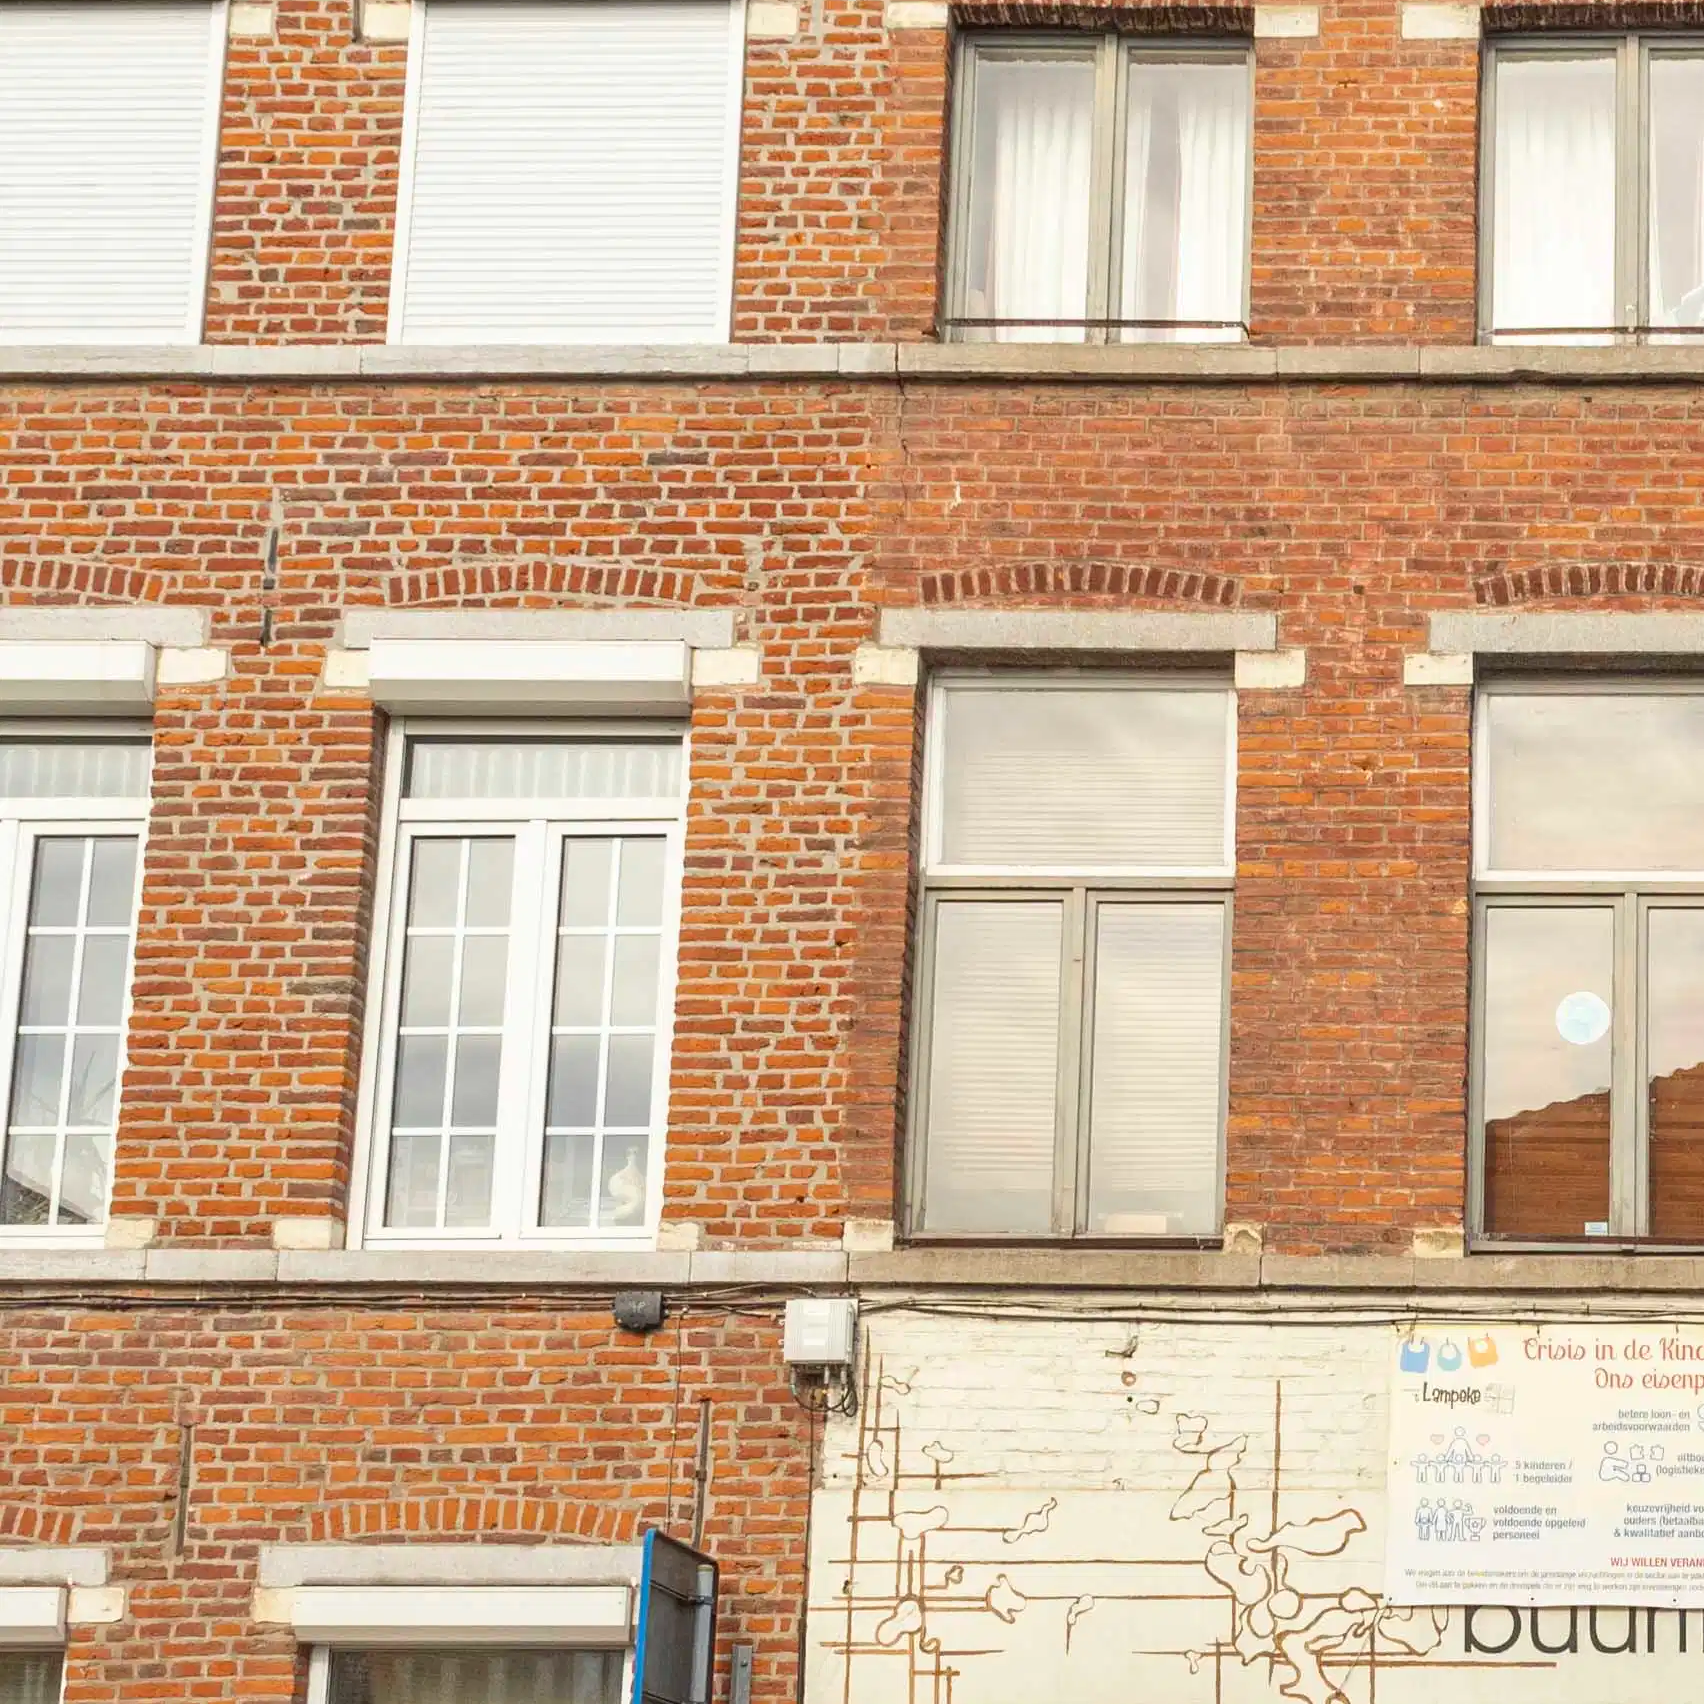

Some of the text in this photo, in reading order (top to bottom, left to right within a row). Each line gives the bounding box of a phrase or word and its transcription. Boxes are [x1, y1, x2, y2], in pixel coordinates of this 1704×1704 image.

[1523, 1336, 1586, 1361] Crisis
[1595, 1337, 1616, 1361] in
[1623, 1338, 1653, 1361] de
[1594, 1367, 1634, 1390] Ons
[1422, 1381, 1482, 1410] Lampeke
[1618, 1409, 1649, 1420] betere
[1592, 1421, 1691, 1433] arbeidsvoorwaarden
[1523, 1460, 1567, 1471] kinderen
[1522, 1474, 1573, 1485] begeleider
[1493, 1505, 1558, 1515] voldoende en
[1626, 1503, 1691, 1515] keuzevrijheid
[1492, 1517, 1587, 1530] voldoende opgeleid
[1623, 1516, 1657, 1526] ouders
[1492, 1529, 1541, 1541] personeel
[1623, 1528, 1676, 1539] kwalitatief
[1610, 1556, 1628, 1568] WIJ
[1631, 1556, 1667, 1568] WILLEN
